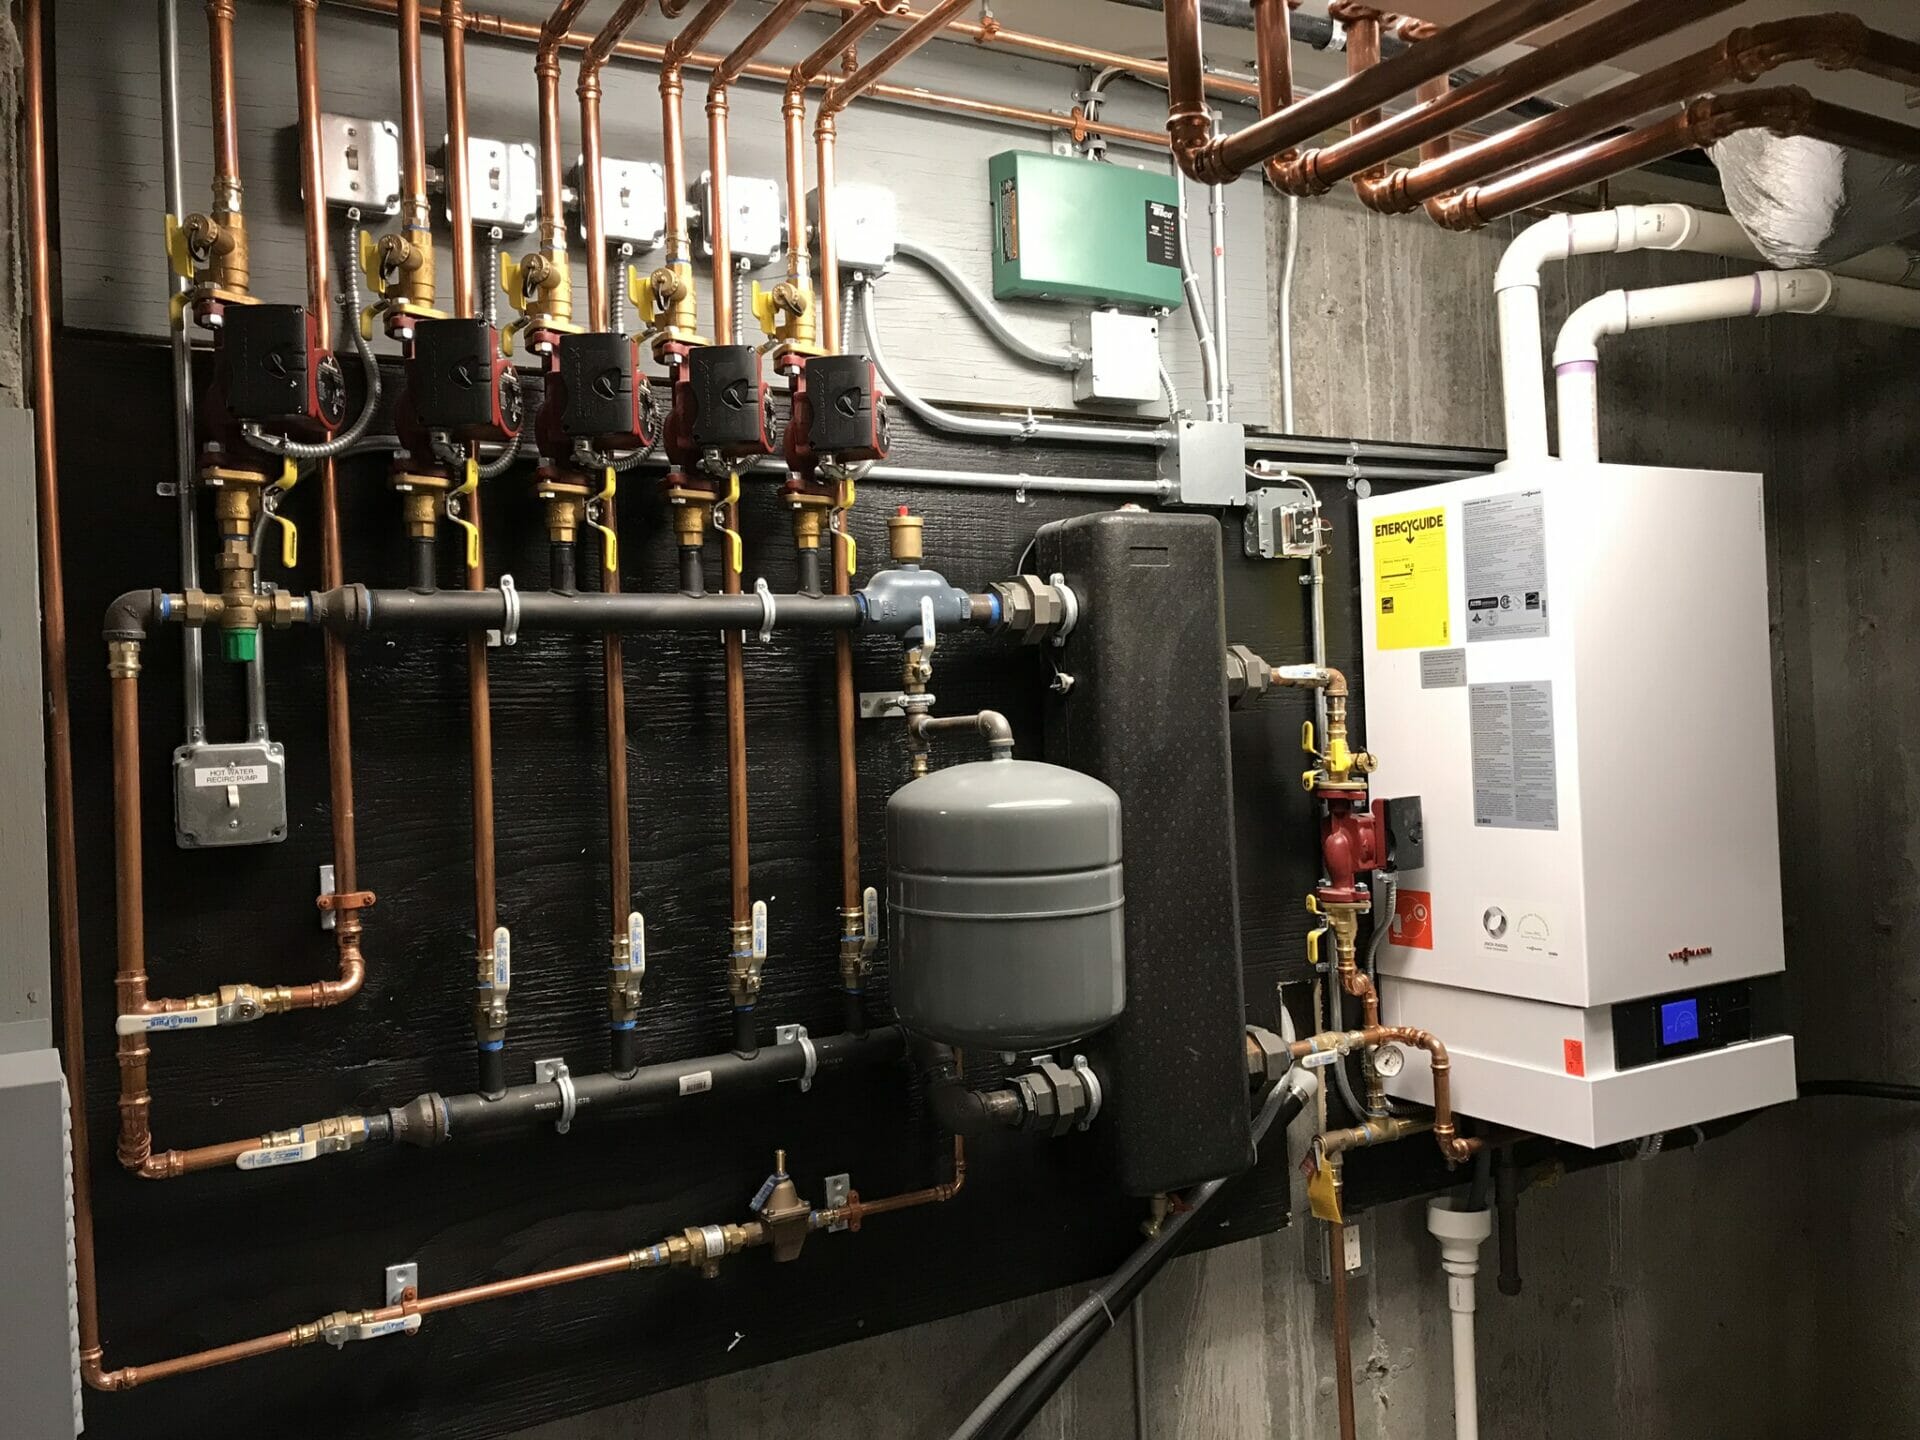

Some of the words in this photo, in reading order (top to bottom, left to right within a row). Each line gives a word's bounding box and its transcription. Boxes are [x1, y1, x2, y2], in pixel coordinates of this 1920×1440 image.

[1375, 514, 1443, 538] ENERGYGUIDE
[206, 775, 235, 783] RECIRC
[179, 1016, 197, 1024] Ultra
